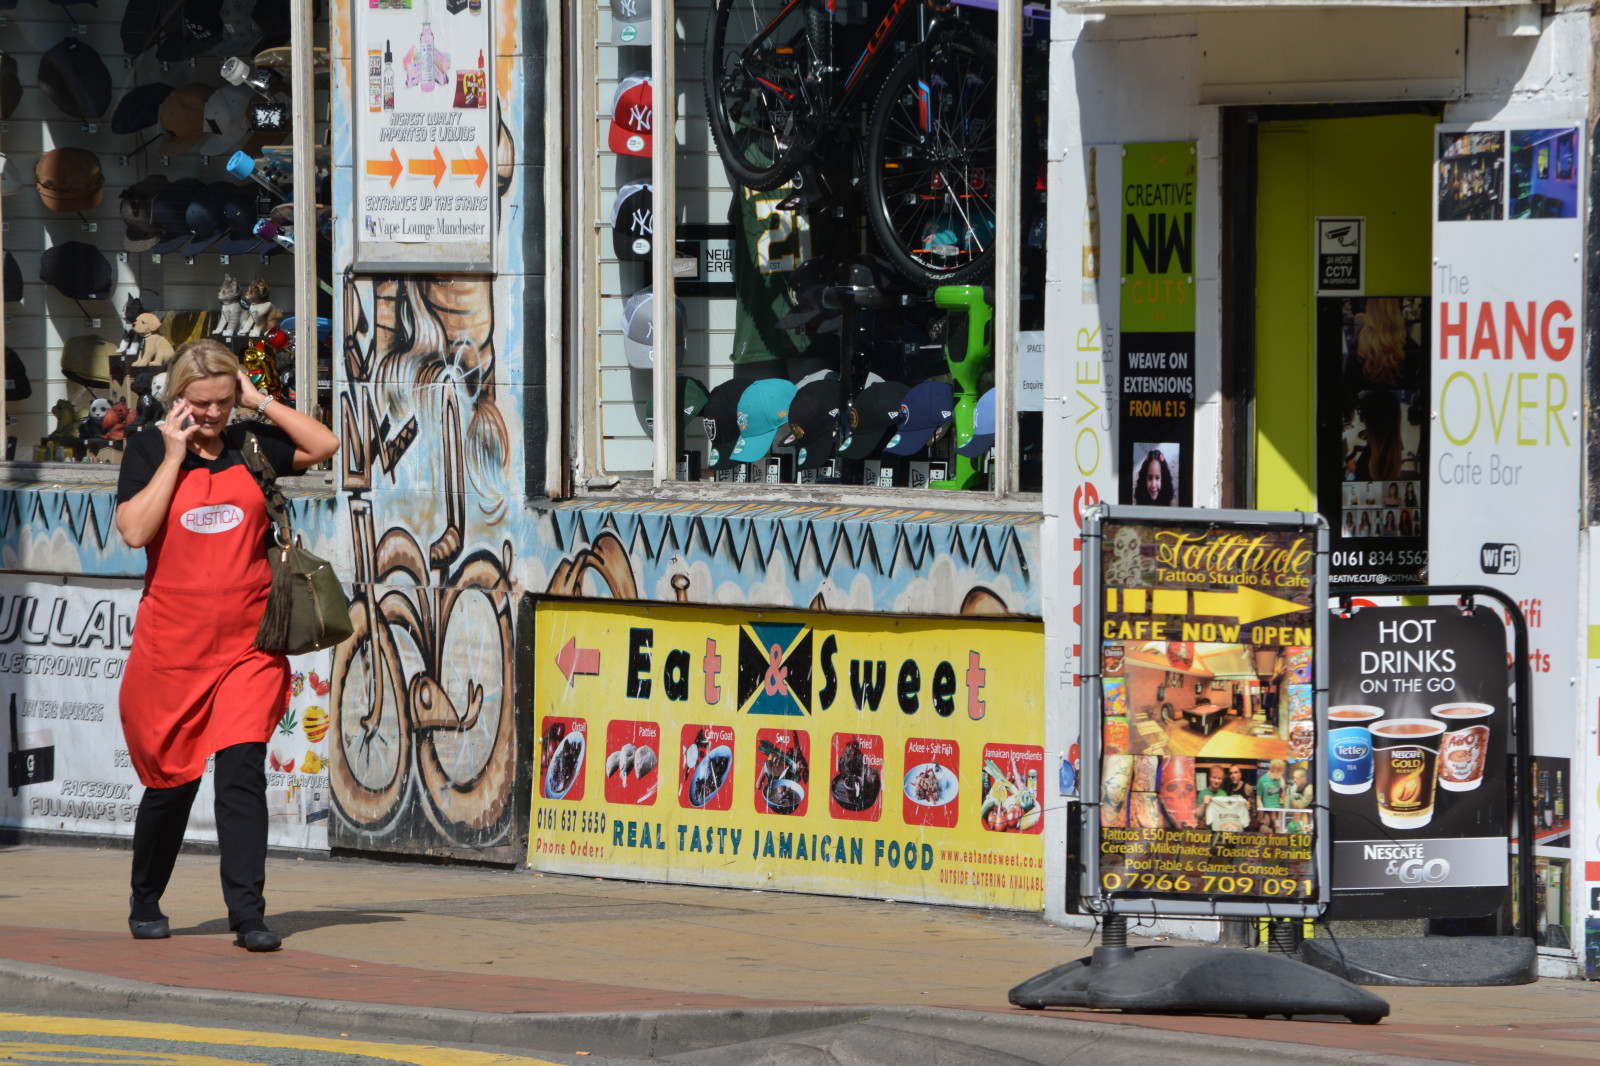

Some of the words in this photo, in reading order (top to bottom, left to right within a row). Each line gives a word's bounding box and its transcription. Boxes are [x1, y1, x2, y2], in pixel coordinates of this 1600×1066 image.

[391, 112, 425, 126] HIGHEST
[428, 112, 462, 126] QUALITY
[380, 127, 427, 142] IMPORTED
[430, 127, 436, 141] E
[439, 127, 475, 142] LIQUIDS
[366, 196, 418, 212] ENTRANCE
[420, 196, 433, 212] UP
[435, 196, 453, 212] THE
[455, 196, 488, 212] STAIRS
[1126, 183, 1193, 207] CREATIVE
[378, 218, 400, 240] Vape
[402, 218, 434, 240] Lounge
[437, 218, 485, 236] Manchester
[1126, 212, 1192, 274] NW
[706, 249, 732, 260] NEW
[1335, 256, 1353, 264] HOUR
[706, 262, 732, 272] ERA
[1326, 266, 1353, 277] CCTV
[1438, 265, 1469, 295] The
[1132, 280, 1186, 303] CUTS
[1440, 300, 1575, 362] HANG
[1027, 344, 1042, 353] SPACE
[1102, 323, 1114, 363] Bar
[1128, 352, 1166, 369] WEAVE
[1169, 352, 1188, 369] ON
[1023, 380, 1044, 391] Enquire
[1124, 376, 1193, 394] EXTENSIONS
[1075, 324, 1101, 477] OVER
[1130, 400, 1162, 417] FROM
[1165, 400, 1186, 418] £15
[1440, 370, 1571, 446] OVER
[1438, 452, 1482, 485] Cafe
[1490, 454, 1522, 485] Bar
[186, 509, 240, 526] RUSTICA
[1155, 531, 1312, 575] Tattitude
[1332, 551, 1364, 566] 0161
[1368, 551, 1394, 566] 834
[1398, 551, 1429, 566] 5562
[1156, 568, 1206, 583] Tattoo
[1209, 571, 1258, 585] Studio
[1261, 574, 1272, 586] &
[1274, 573, 1310, 587] Cafe
[1103, 620, 1167, 641] CAFE
[1182, 622, 1241, 642] NOW
[1251, 625, 1312, 646] OPEN
[1379, 619, 1437, 644] HOT
[0, 652, 101, 678] LECTRONIC
[1361, 649, 1456, 674] DRINKS
[626, 627, 721, 705] Eat
[764, 643, 788, 696] &
[819, 634, 986, 721] Sweet
[1360, 679, 1388, 694] ON
[1392, 679, 1422, 693] THE
[1427, 677, 1456, 692] GO
[572, 722, 586, 732] Oxtail
[639, 727, 656, 738] Patties
[704, 729, 719, 742] Curry
[720, 731, 733, 741] Goat
[776, 733, 790, 745] Soup
[859, 739, 872, 749] Fried
[909, 742, 923, 752] Ackee
[931, 743, 941, 754] Salt
[942, 744, 953, 755] Fish
[984, 748, 1009, 759] Jamaican
[1010, 750, 1042, 762] Ingredients
[1337, 746, 1367, 758] Tetley
[863, 754, 883, 766] Chicken
[1392, 759, 1421, 769] GOLD
[60, 780, 133, 800] FACEBOOK
[29, 797, 116, 821] FULLAVAPE
[537, 807, 557, 830] 0161
[561, 810, 577, 832] 637
[582, 811, 606, 834] 5650
[613, 820, 666, 850] REAL
[678, 825, 742, 855] TASTY
[753, 830, 863, 865] JAMAICAN
[875, 839, 934, 870] FOOD
[1102, 828, 1140, 841] Tattoos
[1143, 829, 1164, 841] £50
[1165, 832, 1183, 842] per
[1185, 830, 1212, 844] hour
[1222, 833, 1267, 848] Piercings
[1268, 835, 1288, 846] from
[1289, 835, 1311, 847] £10
[536, 837, 566, 856] Phone
[570, 840, 604, 858] Orders
[1216, 845, 1260, 858] Toasties
[1262, 847, 1272, 858] &
[1274, 847, 1312, 860] Paninis
[1364, 844, 1424, 860] NESCAFÉ
[1124, 859, 1152, 871] Pool
[1154, 860, 1183, 871] Table
[1185, 860, 1194, 872] &
[1197, 861, 1236, 873] Games
[1238, 863, 1289, 876] Consoles
[940, 869, 968, 885] OUTSIDE
[972, 872, 1006, 888] CATERING
[1010, 875, 1044, 892] AVAILABL
[1103, 873, 1191, 892] 07966
[1201, 876, 1254, 894] 709
[1263, 878, 1312, 896] 091
